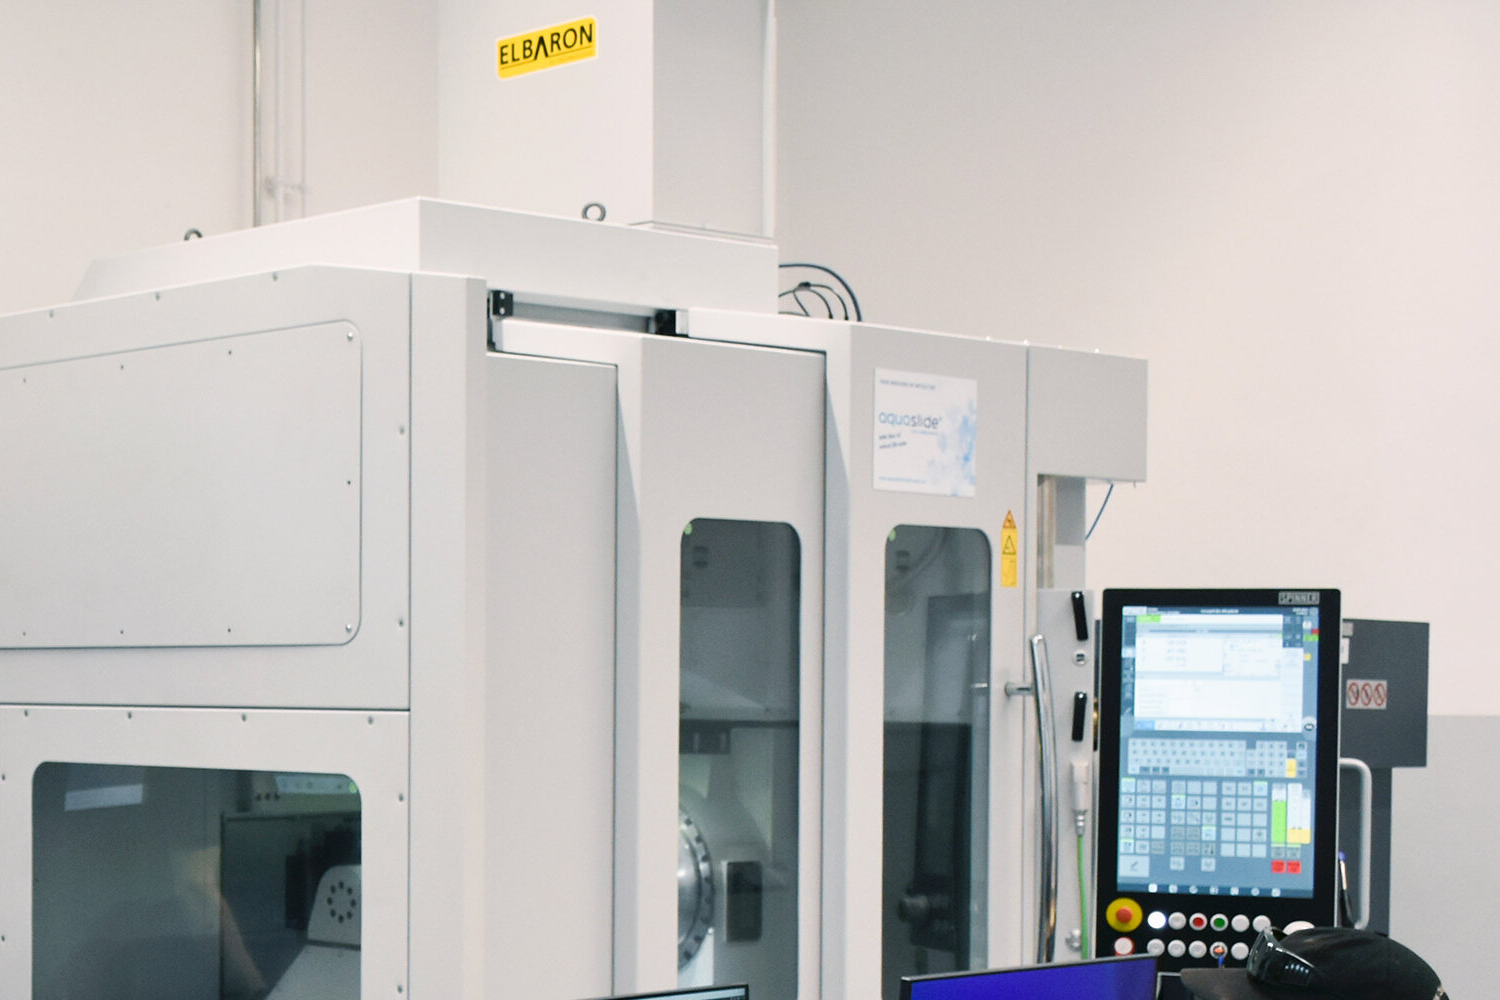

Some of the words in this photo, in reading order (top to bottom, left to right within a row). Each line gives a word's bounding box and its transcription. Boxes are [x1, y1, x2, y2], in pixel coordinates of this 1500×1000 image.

[500, 23, 593, 65] ELBARON
[878, 411, 939, 430] aquaslide
[1279, 593, 1319, 604] SPINNER
